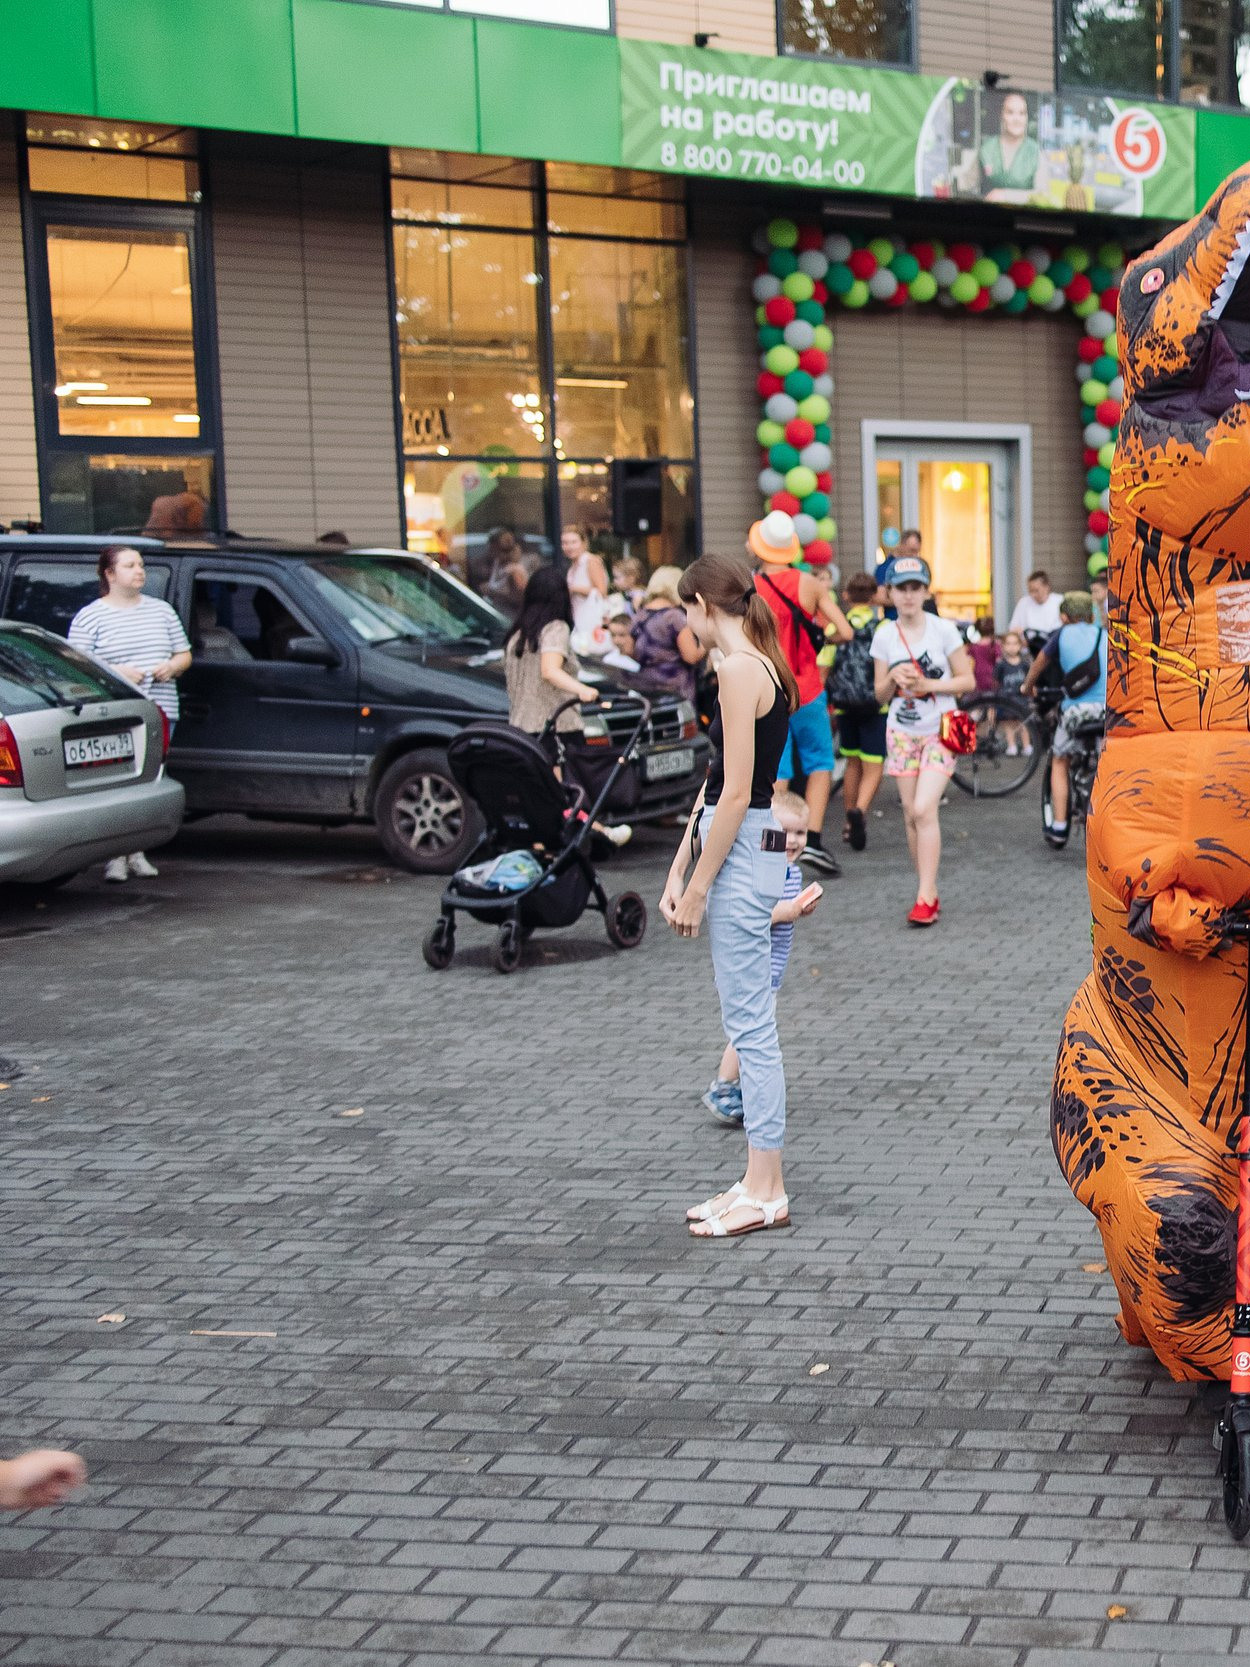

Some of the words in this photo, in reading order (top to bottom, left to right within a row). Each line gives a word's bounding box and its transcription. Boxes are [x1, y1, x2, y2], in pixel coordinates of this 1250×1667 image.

[659, 61, 871, 113] Приглашаем
[660, 104, 704, 131] на
[712, 108, 839, 152] работу!
[661, 141, 677, 167] 8
[683, 143, 732, 172] 800
[738, 149, 865, 185] 770-04-00
